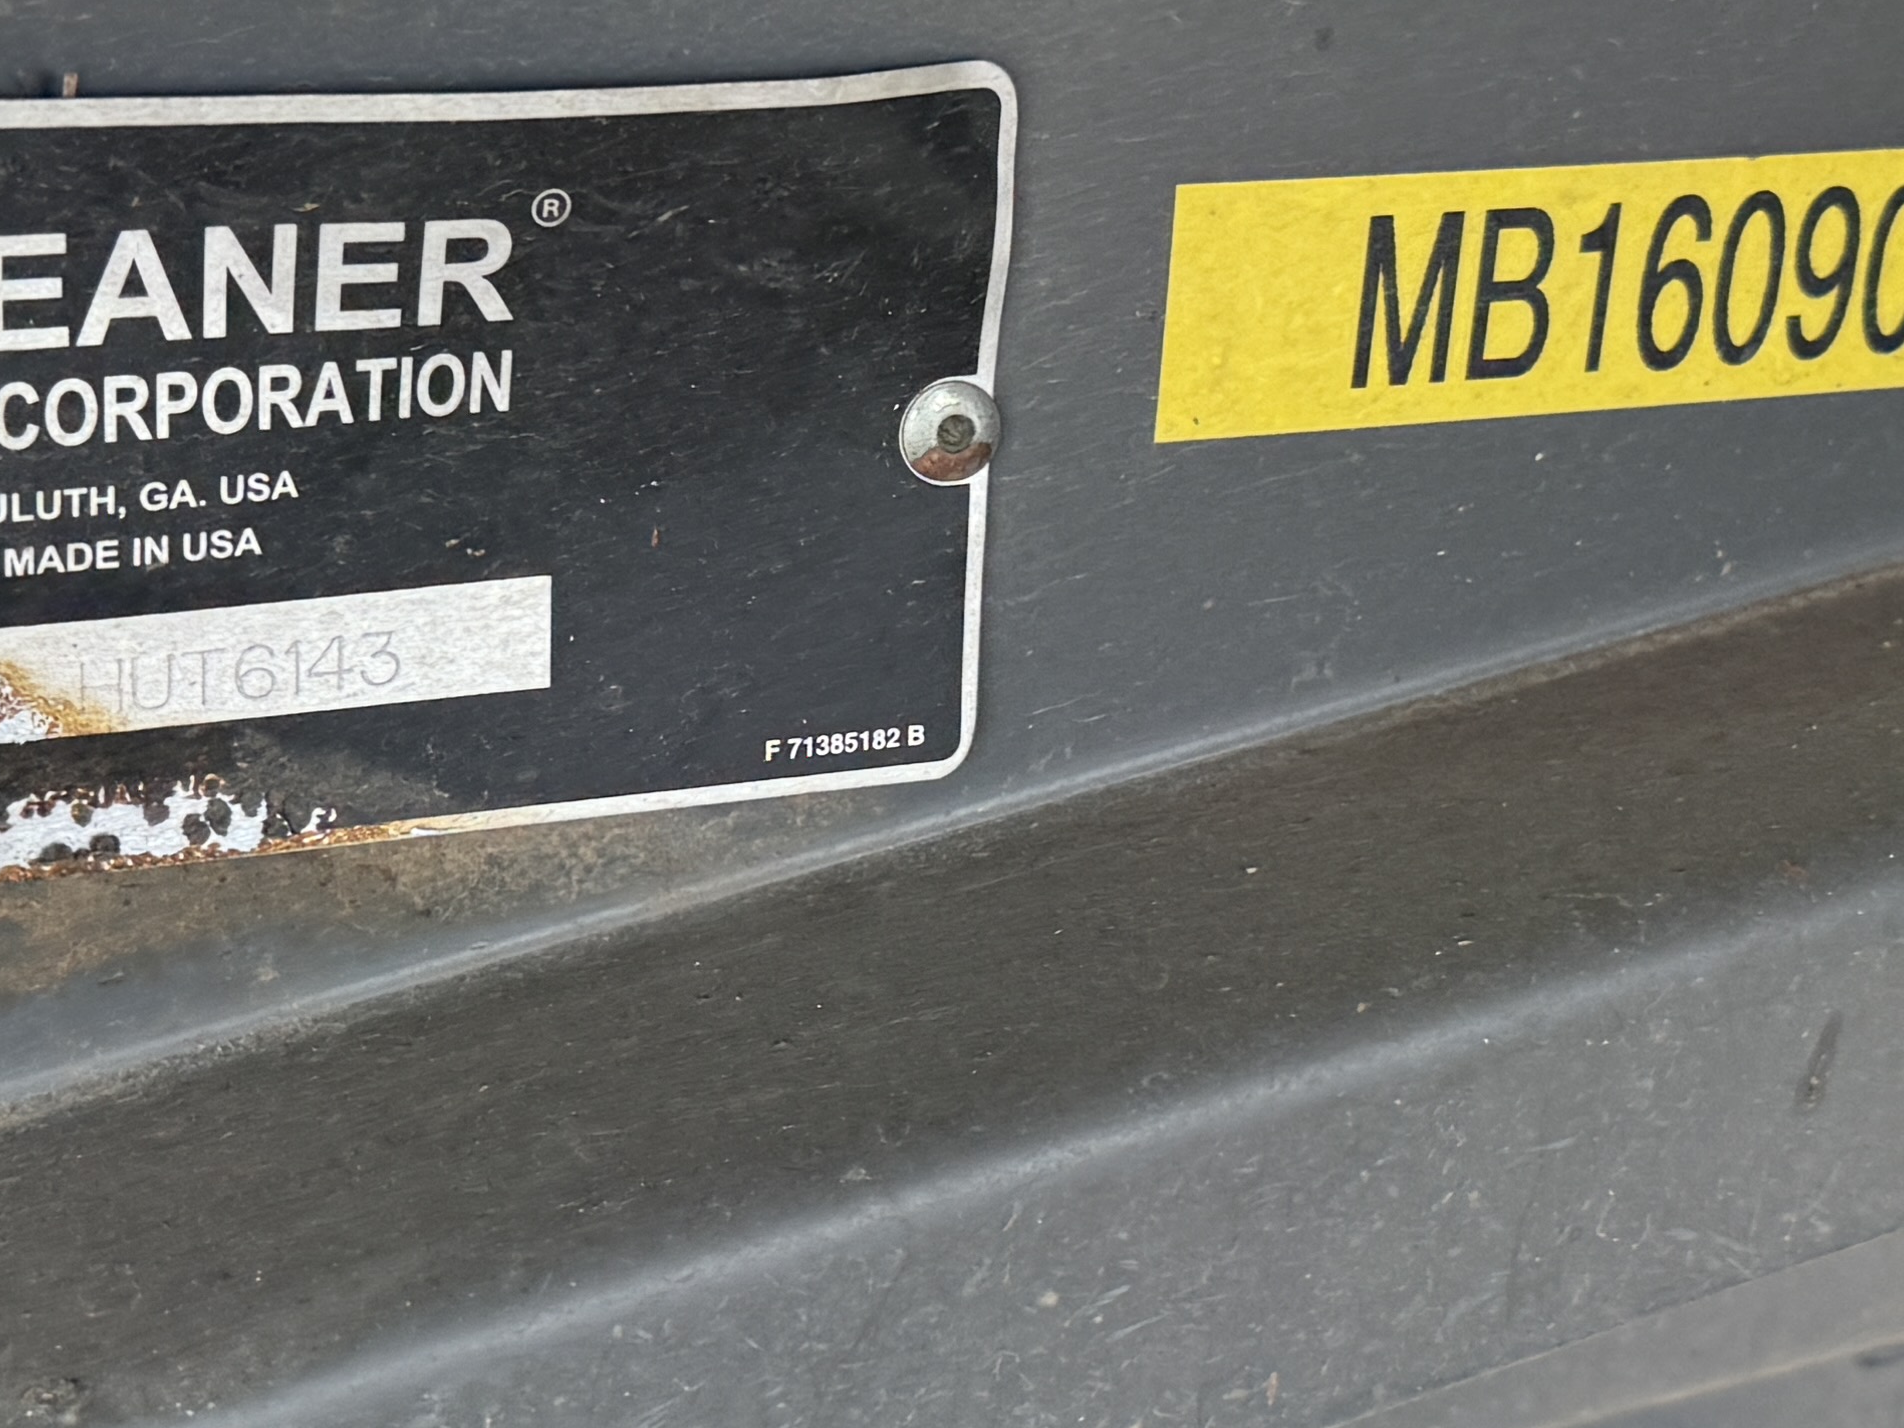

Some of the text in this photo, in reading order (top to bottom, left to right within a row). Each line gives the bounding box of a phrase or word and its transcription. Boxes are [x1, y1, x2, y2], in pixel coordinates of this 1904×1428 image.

[140, 480, 206, 511] GA.
[220, 471, 298, 504] USA
[4, 528, 262, 577] MADE IN USA
[78, 630, 401, 713] HUT6143
[765, 725, 924, 761] F 71385182 B
